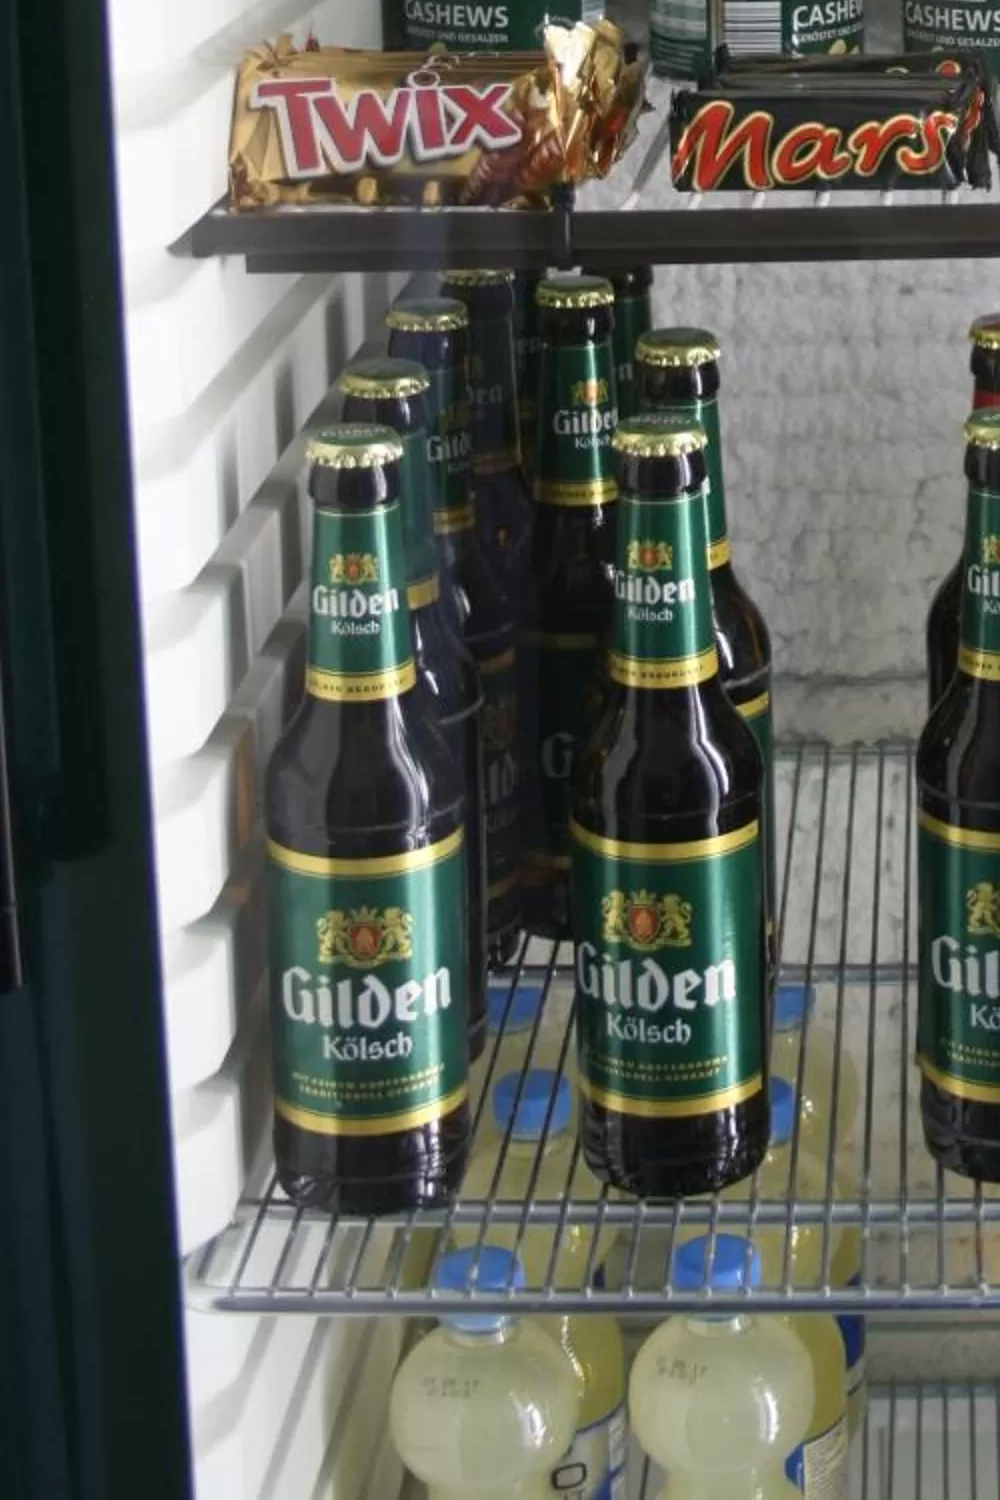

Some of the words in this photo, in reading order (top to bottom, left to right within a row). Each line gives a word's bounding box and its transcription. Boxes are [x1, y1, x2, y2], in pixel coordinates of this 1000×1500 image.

[676, 100, 957, 190] Mars
[313, 585, 398, 618] Gilden
[614, 570, 696, 606] Gilden
[331, 619, 381, 637] Kölsch
[627, 605, 673, 622] Kölsch
[577, 941, 736, 1012] Gilden
[282, 966, 452, 1030] Gilden
[607, 1011, 692, 1044] Kölsch
[322, 1031, 413, 1062] Kölsch
